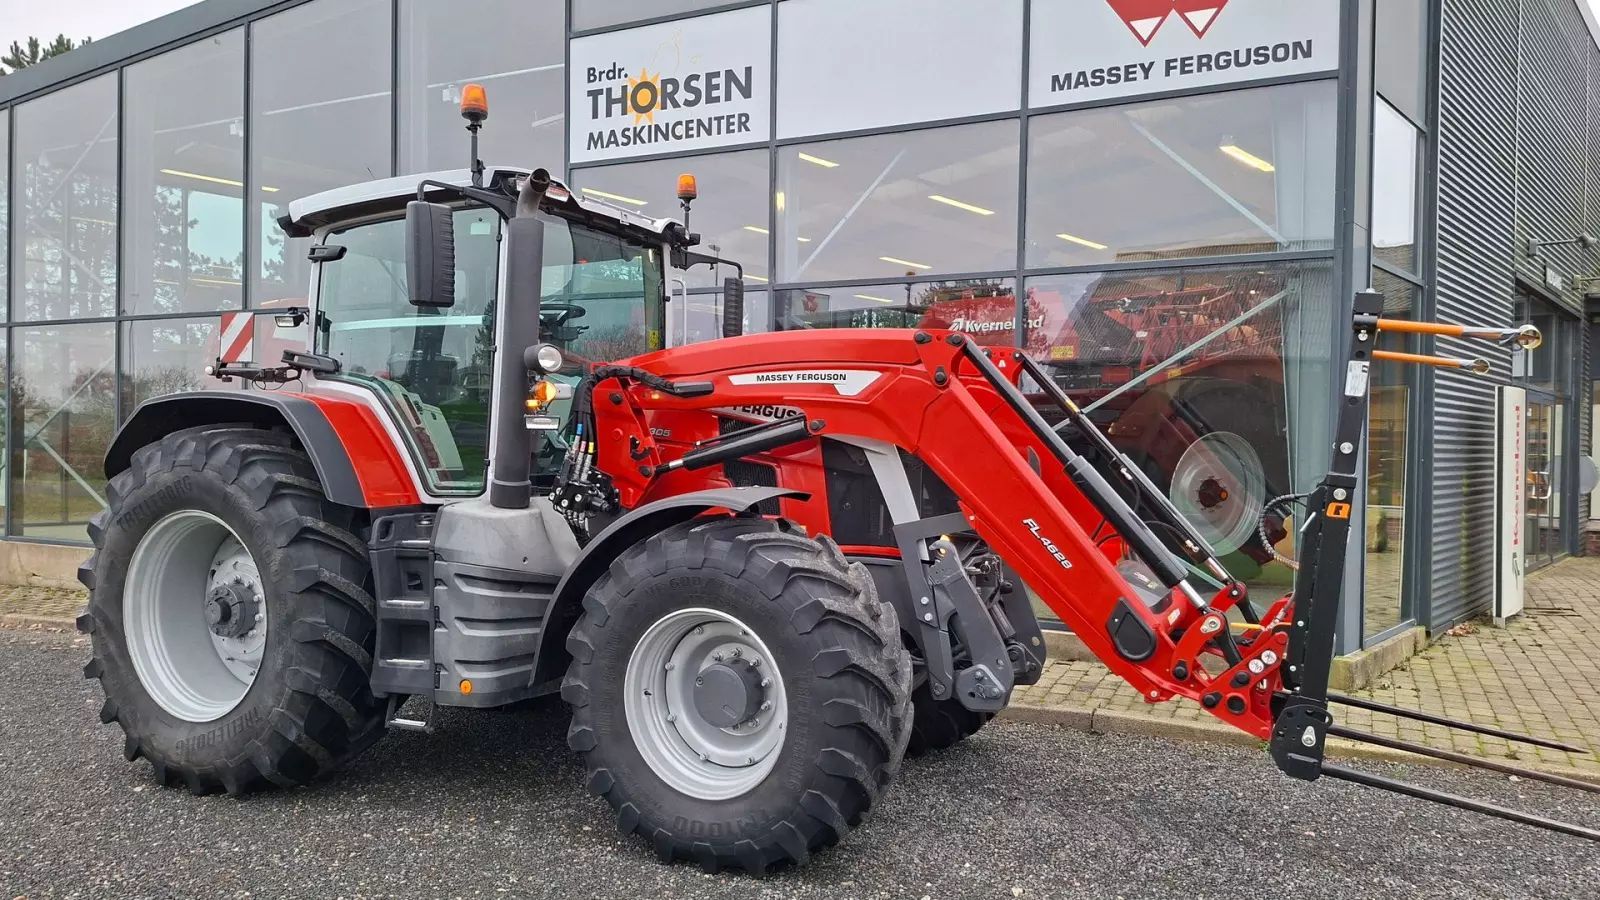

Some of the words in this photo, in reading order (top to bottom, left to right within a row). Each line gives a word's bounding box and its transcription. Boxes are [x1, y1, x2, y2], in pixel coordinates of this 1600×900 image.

[586, 61, 629, 84] Brdr.
[1050, 60, 1155, 93] MASSEY
[1163, 39, 1313, 78] FERGUSON
[586, 66, 753, 120] THORSEN
[586, 112, 751, 151] MASKINCENTER
[965, 314, 1045, 333] Kvernelnd
[756, 373, 794, 382] MASSEY
[796, 373, 847, 381] FERGUSON
